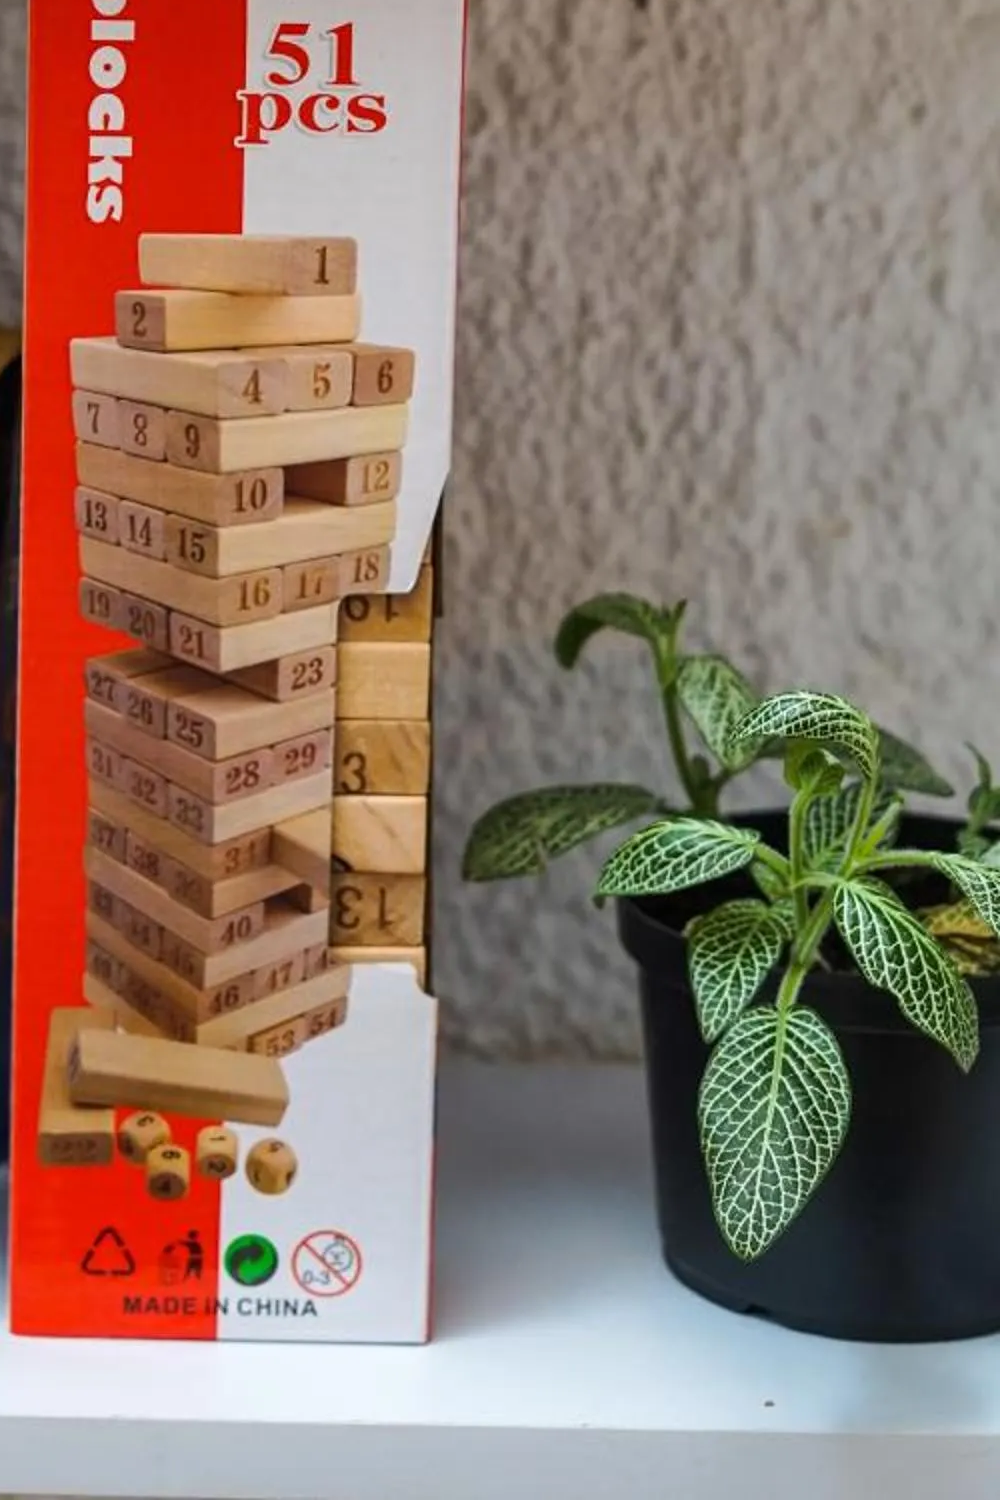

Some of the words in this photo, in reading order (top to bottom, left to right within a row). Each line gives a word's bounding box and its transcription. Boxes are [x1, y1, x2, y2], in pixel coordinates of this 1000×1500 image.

[266, 22, 360, 87] 51
[235, 88, 388, 148] pcs
[313, 246, 329, 284] 1
[132, 302, 147, 337] 2
[242, 369, 263, 404] 4
[313, 363, 331, 399] 5
[377, 361, 393, 394] 6
[87, 404, 100, 434] 7
[134, 414, 147, 446] 8
[185, 424, 199, 458] 9
[361, 461, 389, 494] 12
[234, 479, 267, 513] 10
[83, 501, 107, 530] 13
[127, 515, 151, 547] 14
[177, 533, 206, 563] 15
[299, 568, 326, 599] 17
[353, 553, 379, 583] 18
[89, 589, 111, 618] 19
[237, 578, 270, 611] 16
[128, 606, 155, 639] 20
[180, 625, 204, 658] 21
[92, 671, 115, 703] 27
[290, 658, 324, 689] 23
[128, 693, 153, 725] 26
[175, 714, 203, 747] 25
[285, 744, 316, 774] 29
[226, 760, 260, 794] 28
[123, 1297, 197, 1317] MADE
[205, 1297, 229, 1317] IN
[237, 1299, 318, 1318] CHINA
